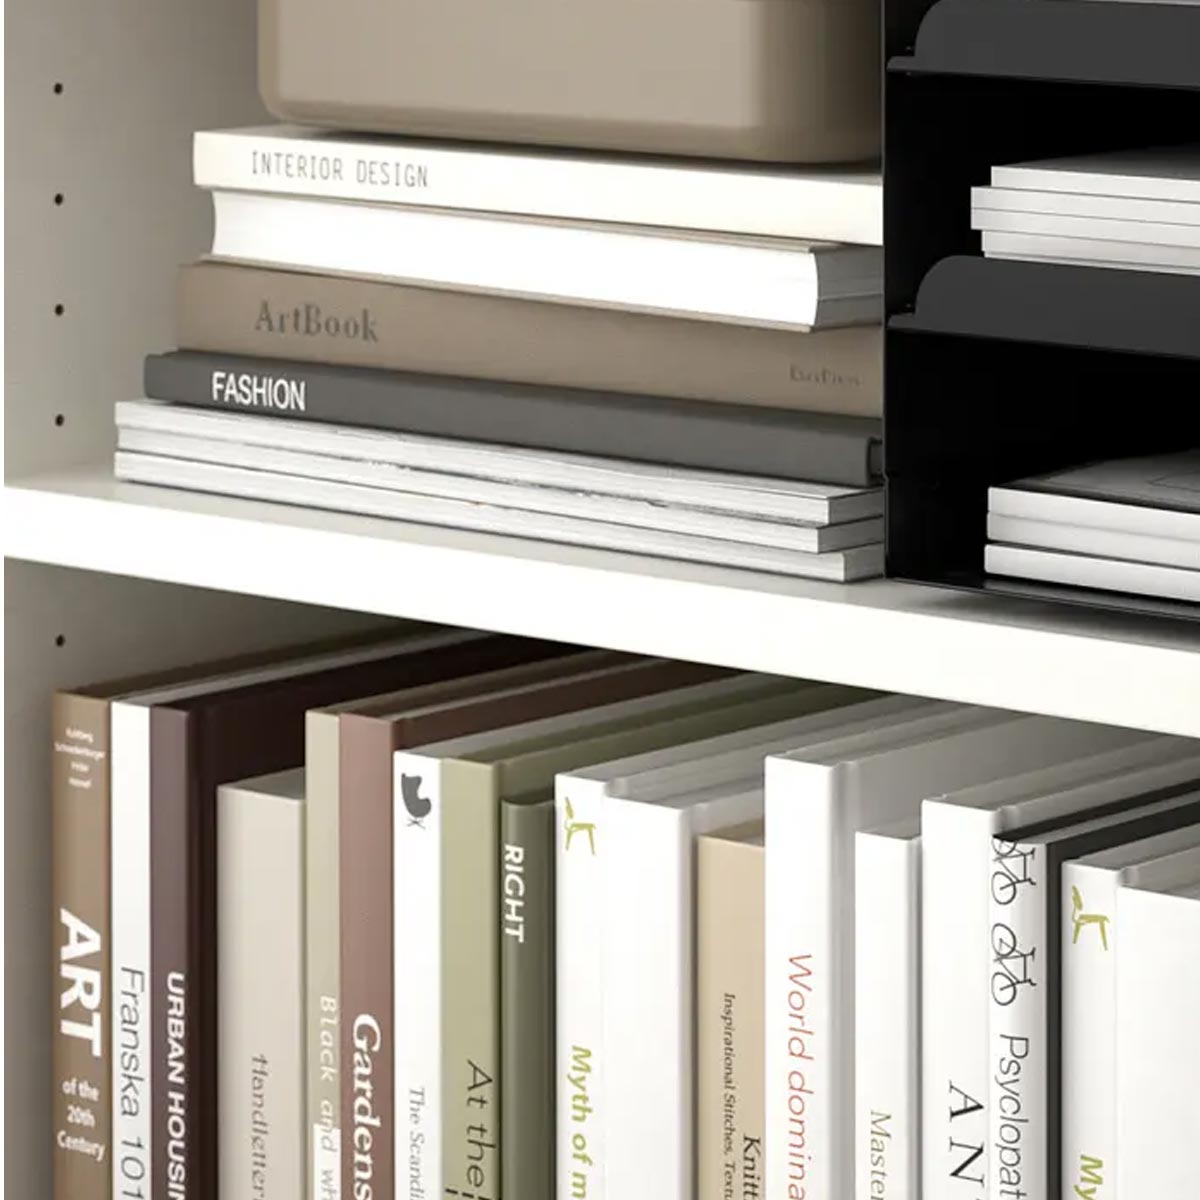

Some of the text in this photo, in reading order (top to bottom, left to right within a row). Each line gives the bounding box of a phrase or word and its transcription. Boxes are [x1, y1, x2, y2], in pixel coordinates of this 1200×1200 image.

[252, 150, 429, 188] INTERIOR DESIGN
[255, 300, 379, 343] ArtBook
[211, 370, 306, 412] FASHION
[504, 843, 525, 943] RIGHT
[60, 907, 102, 1057] ART
[166, 971, 186, 1084] URBAN
[120, 965, 146, 1200] Franska 101
[319, 994, 338, 1083] Black
[566, 1044, 594, 1123] Myth
[720, 992, 736, 1091] Inspirational
[787, 953, 815, 1200] World domina
[62, 1077, 100, 1102] of the
[67, 1104, 96, 1129] 20th
[251, 1053, 269, 1200] Handletter
[319, 1100, 338, 1153] and
[352, 1012, 382, 1200] Gardens
[466, 1059, 497, 1188] At the
[994, 1033, 1030, 1200] Psyclopat
[57, 1130, 106, 1162] Century
[409, 1087, 425, 1200] The Scandi
[571, 1132, 594, 1167] of
[947, 1079, 985, 1200] AN
